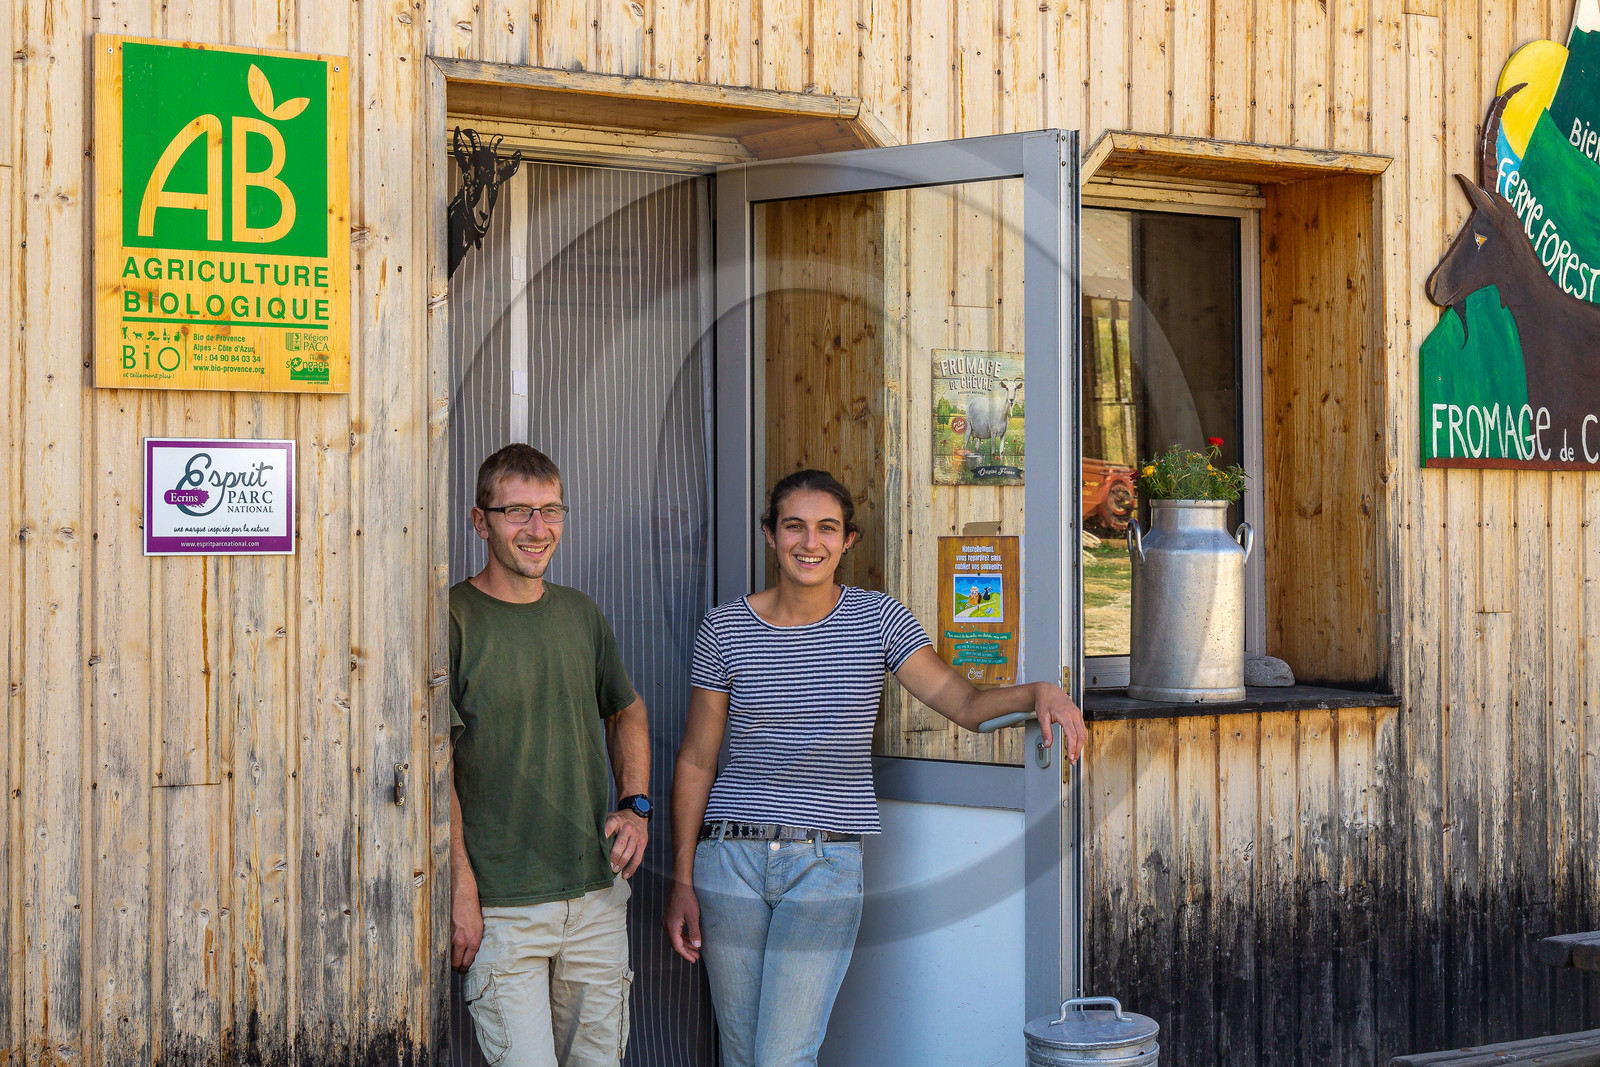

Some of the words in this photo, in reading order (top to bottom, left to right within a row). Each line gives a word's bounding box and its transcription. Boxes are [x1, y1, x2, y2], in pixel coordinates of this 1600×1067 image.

[137, 114, 296, 243] AB
[122, 257, 329, 287] AGRICULTURE
[124, 291, 329, 320] BIOLOGIQUE
[216, 334, 246, 342] Provence
[304, 333, 328, 343] Région
[193, 344, 211, 352] Alpes
[218, 344, 232, 352] Côte
[234, 345, 255, 353] d'Azur
[304, 342, 329, 351] PACA
[220, 354, 229, 362] 90
[193, 364, 265, 374] www.bio-provence.org
[940, 356, 1001, 379] FROMAGE
[961, 374, 994, 391] CHÈVRE
[1559, 428, 1575, 462] de
[175, 453, 274, 517] Esprit
[170, 492, 199, 503] Ecrins
[228, 490, 273, 504] PARC
[227, 505, 274, 513] NATIONAL
[185, 526, 207, 534] marque
[208, 524, 230, 534] inspirée
[243, 524, 250, 532] la
[251, 524, 270, 532] nature
[181, 540, 260, 548] www.espritparcnational.com
